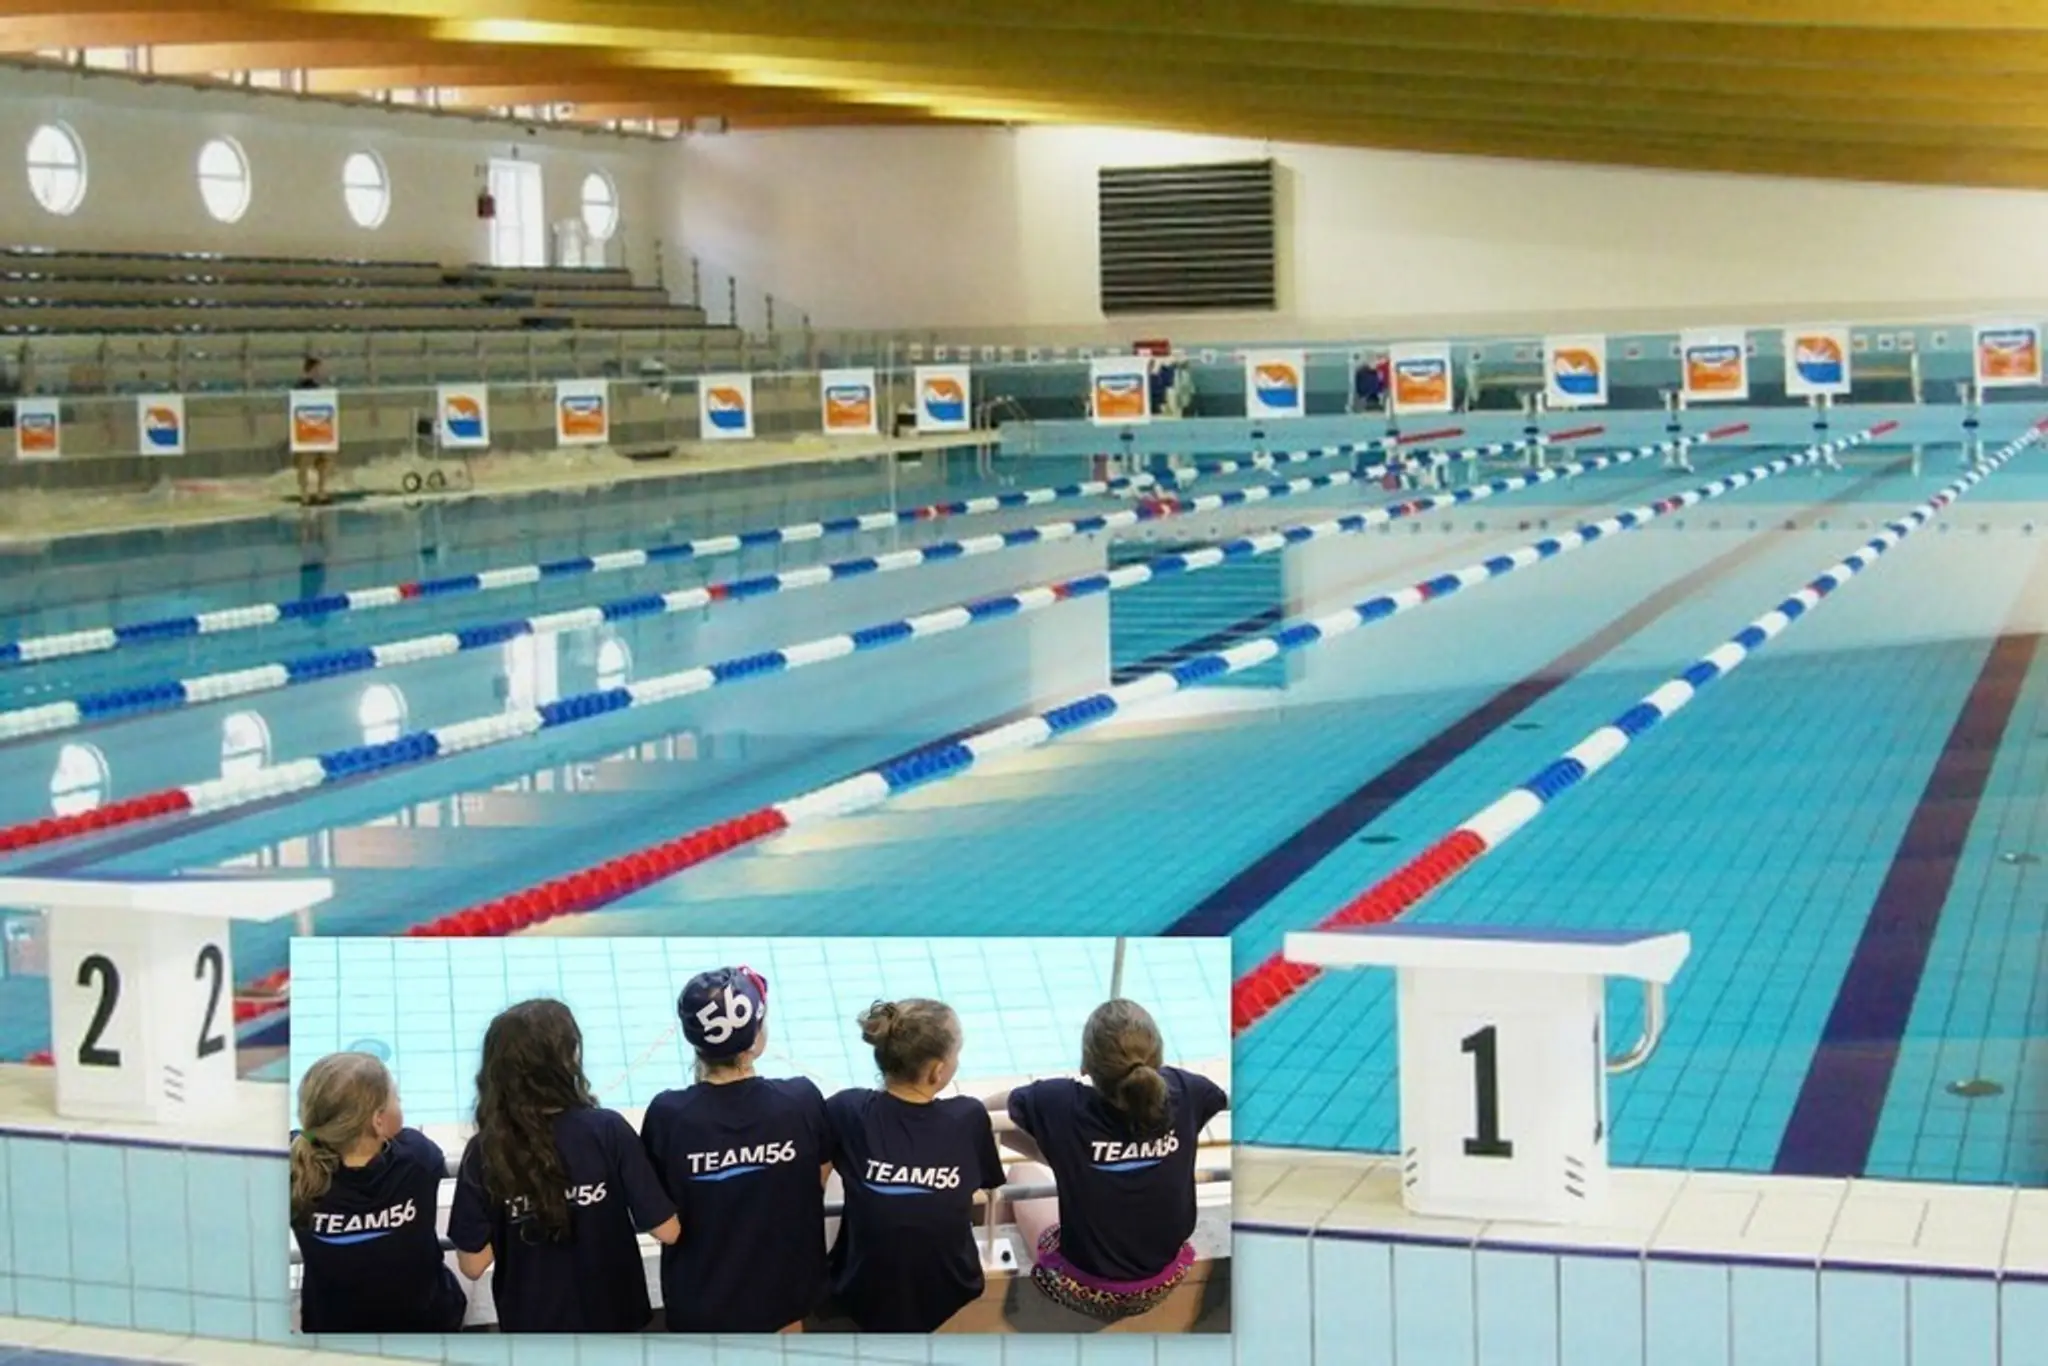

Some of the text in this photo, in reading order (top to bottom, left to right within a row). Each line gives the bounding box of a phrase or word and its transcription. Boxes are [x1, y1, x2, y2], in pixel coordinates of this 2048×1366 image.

[77, 954, 121, 1067] 2
[195, 943, 226, 1060] 2
[696, 984, 753, 1044] 56
[1461, 1025, 1513, 1159] 1
[687, 1140, 797, 1174] TEAM56
[866, 1158, 961, 1190] TEAM56
[313, 1198, 418, 1234] TEAM56
[504, 1182, 608, 1218] T56
